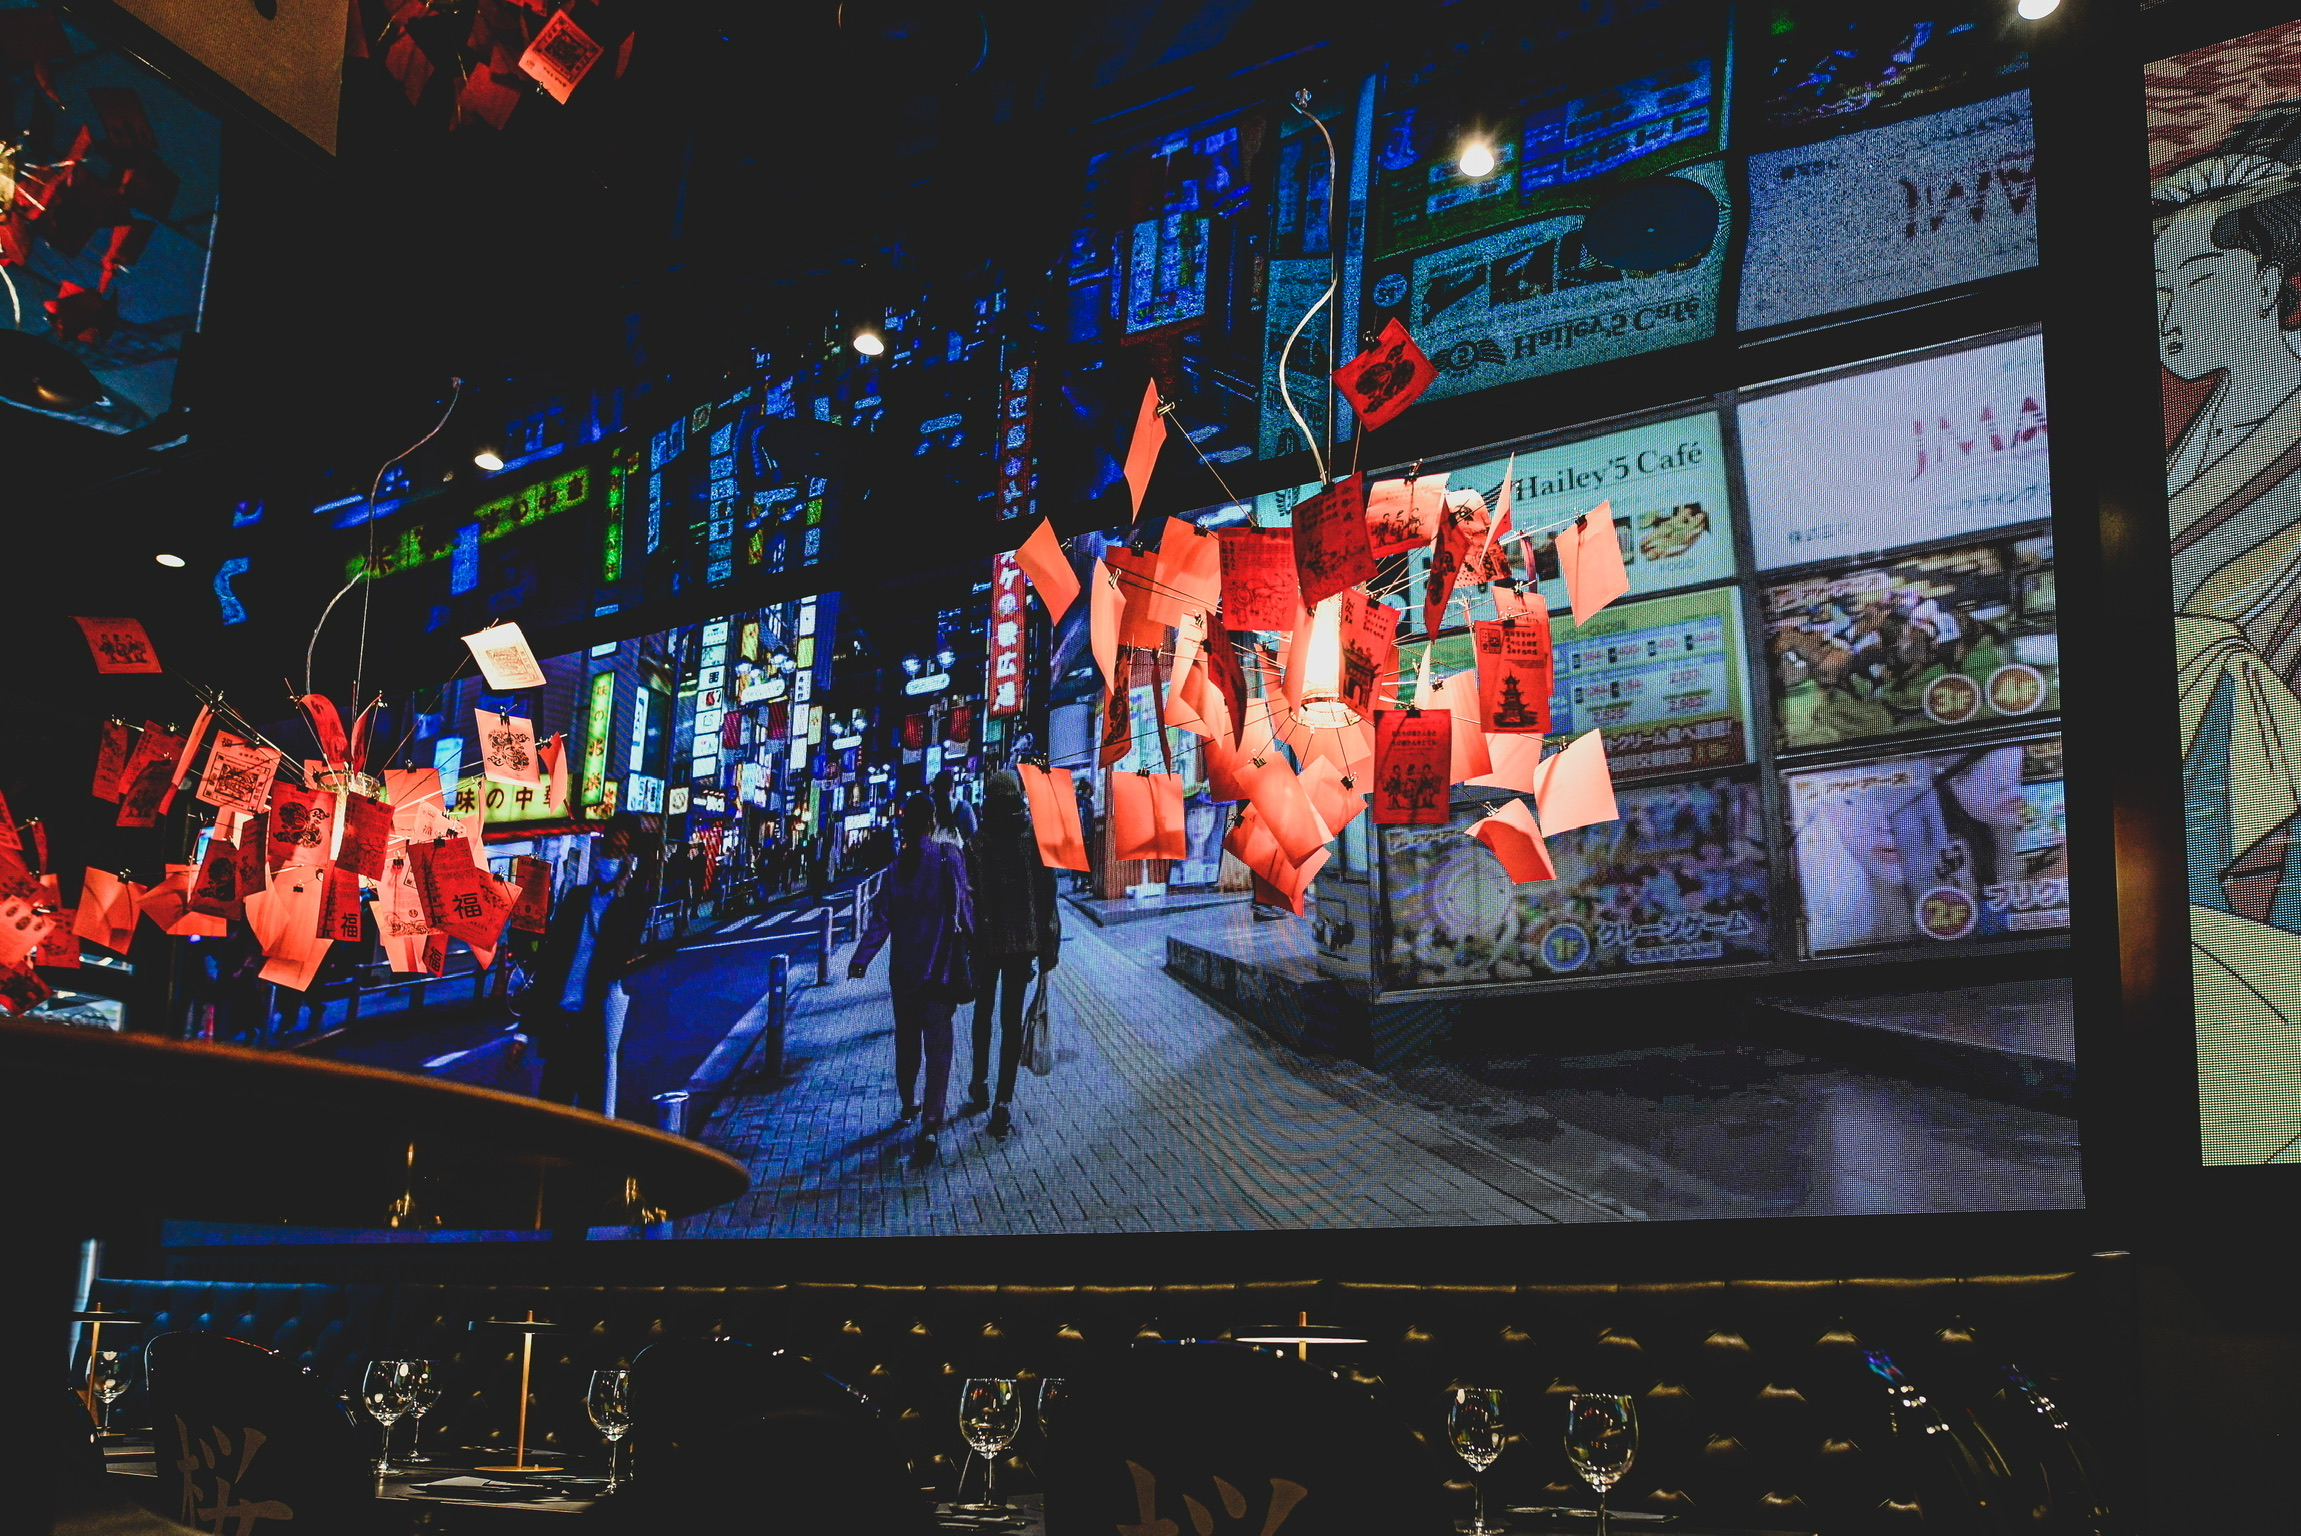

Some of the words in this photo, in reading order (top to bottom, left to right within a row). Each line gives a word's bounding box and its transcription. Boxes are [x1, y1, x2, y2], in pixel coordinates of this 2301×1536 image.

[1637, 441, 1702, 475] Café
[452, 892, 483, 920] 福
[1926, 899, 1969, 929] 2F
[340, 913, 359, 938] 福
[1600, 911, 1750, 945] クレーンゲーム
[427, 946, 442, 972] 福
[1550, 935, 1580, 961] 1F
